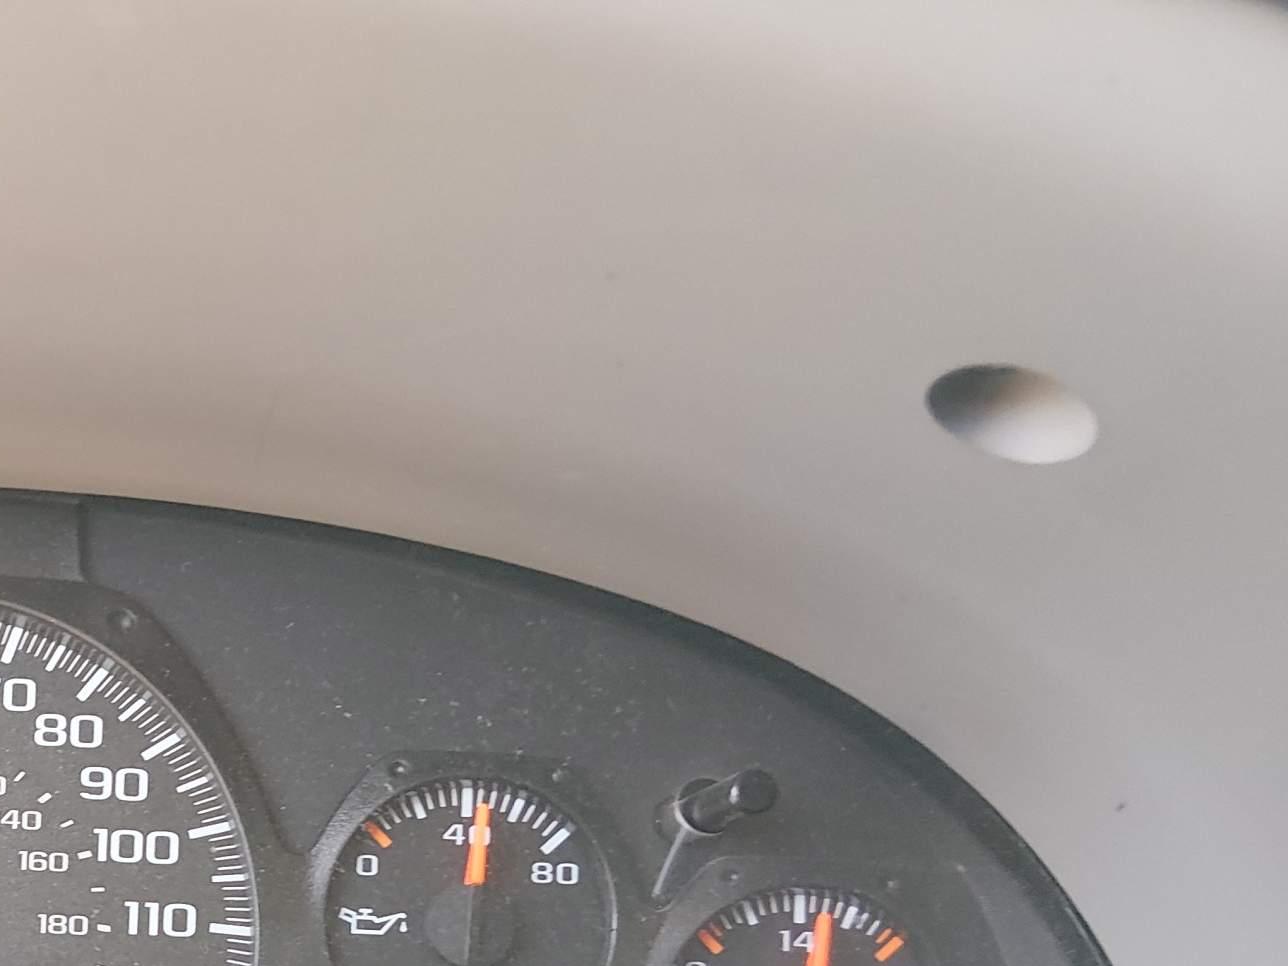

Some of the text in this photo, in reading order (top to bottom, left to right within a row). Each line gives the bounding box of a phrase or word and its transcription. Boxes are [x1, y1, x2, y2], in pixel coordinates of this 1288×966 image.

[34, 714, 103, 748] 80
[80, 767, 148, 801] 90
[442, 823, 491, 846] 40
[94, 829, 179, 864] 100
[19, 851, 68, 871] 160
[356, 855, 378, 875] 0
[531, 863, 578, 884] 80
[38, 914, 88, 935] 180
[125, 902, 196, 937] 110
[779, 931, 813, 953] 14
